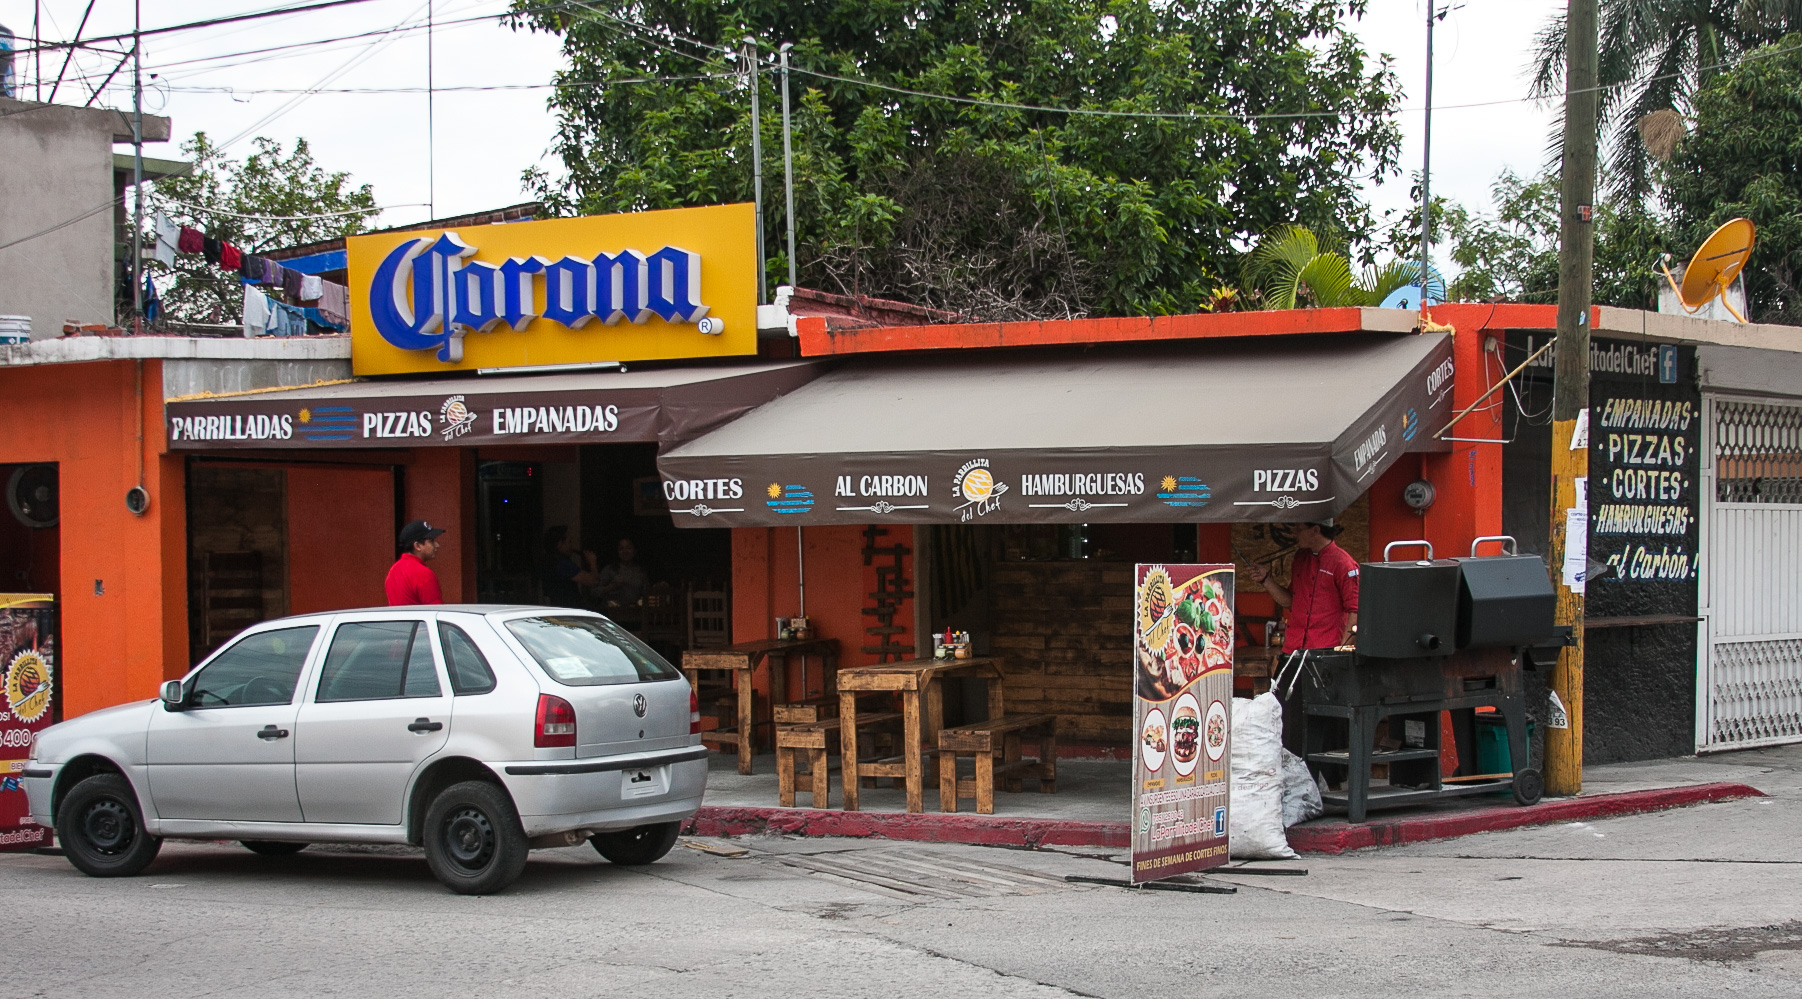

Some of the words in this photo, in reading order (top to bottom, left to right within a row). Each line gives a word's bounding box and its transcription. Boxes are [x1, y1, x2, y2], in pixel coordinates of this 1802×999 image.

[370, 231, 711, 363] Corona
[1426, 356, 1454, 396] CORTES
[171, 414, 293, 440] PARRILLADAS
[363, 411, 432, 438] PIZZAS
[493, 404, 619, 434] EMPANADAS
[1601, 398, 1691, 430] EMPANADAS
[1353, 424, 1387, 472] EMPANADAS
[1609, 433, 1685, 466] PIZZAS
[953, 458, 990, 485] PARRILLITA
[1021, 472, 1145, 496] HAMBURGUESAS
[1253, 468, 1319, 492] PIZZAS
[1612, 468, 1682, 500] CORTES
[663, 478, 744, 501] CORTES
[835, 475, 856, 497] AL
[859, 474, 929, 497] CARBON
[951, 485, 960, 498] LA
[961, 507, 973, 523] del
[977, 496, 1002, 517] Chef
[1595, 504, 1689, 535] HAMBURGUESAS
[1136, 859, 1153, 872] FINES
[1153, 857, 1161, 869] DE
[1161, 854, 1185, 867] SEMANA
[1185, 852, 1193, 862] DE
[1193, 847, 1213, 860] CORTES
[1213, 844, 1228, 857] FINOS
